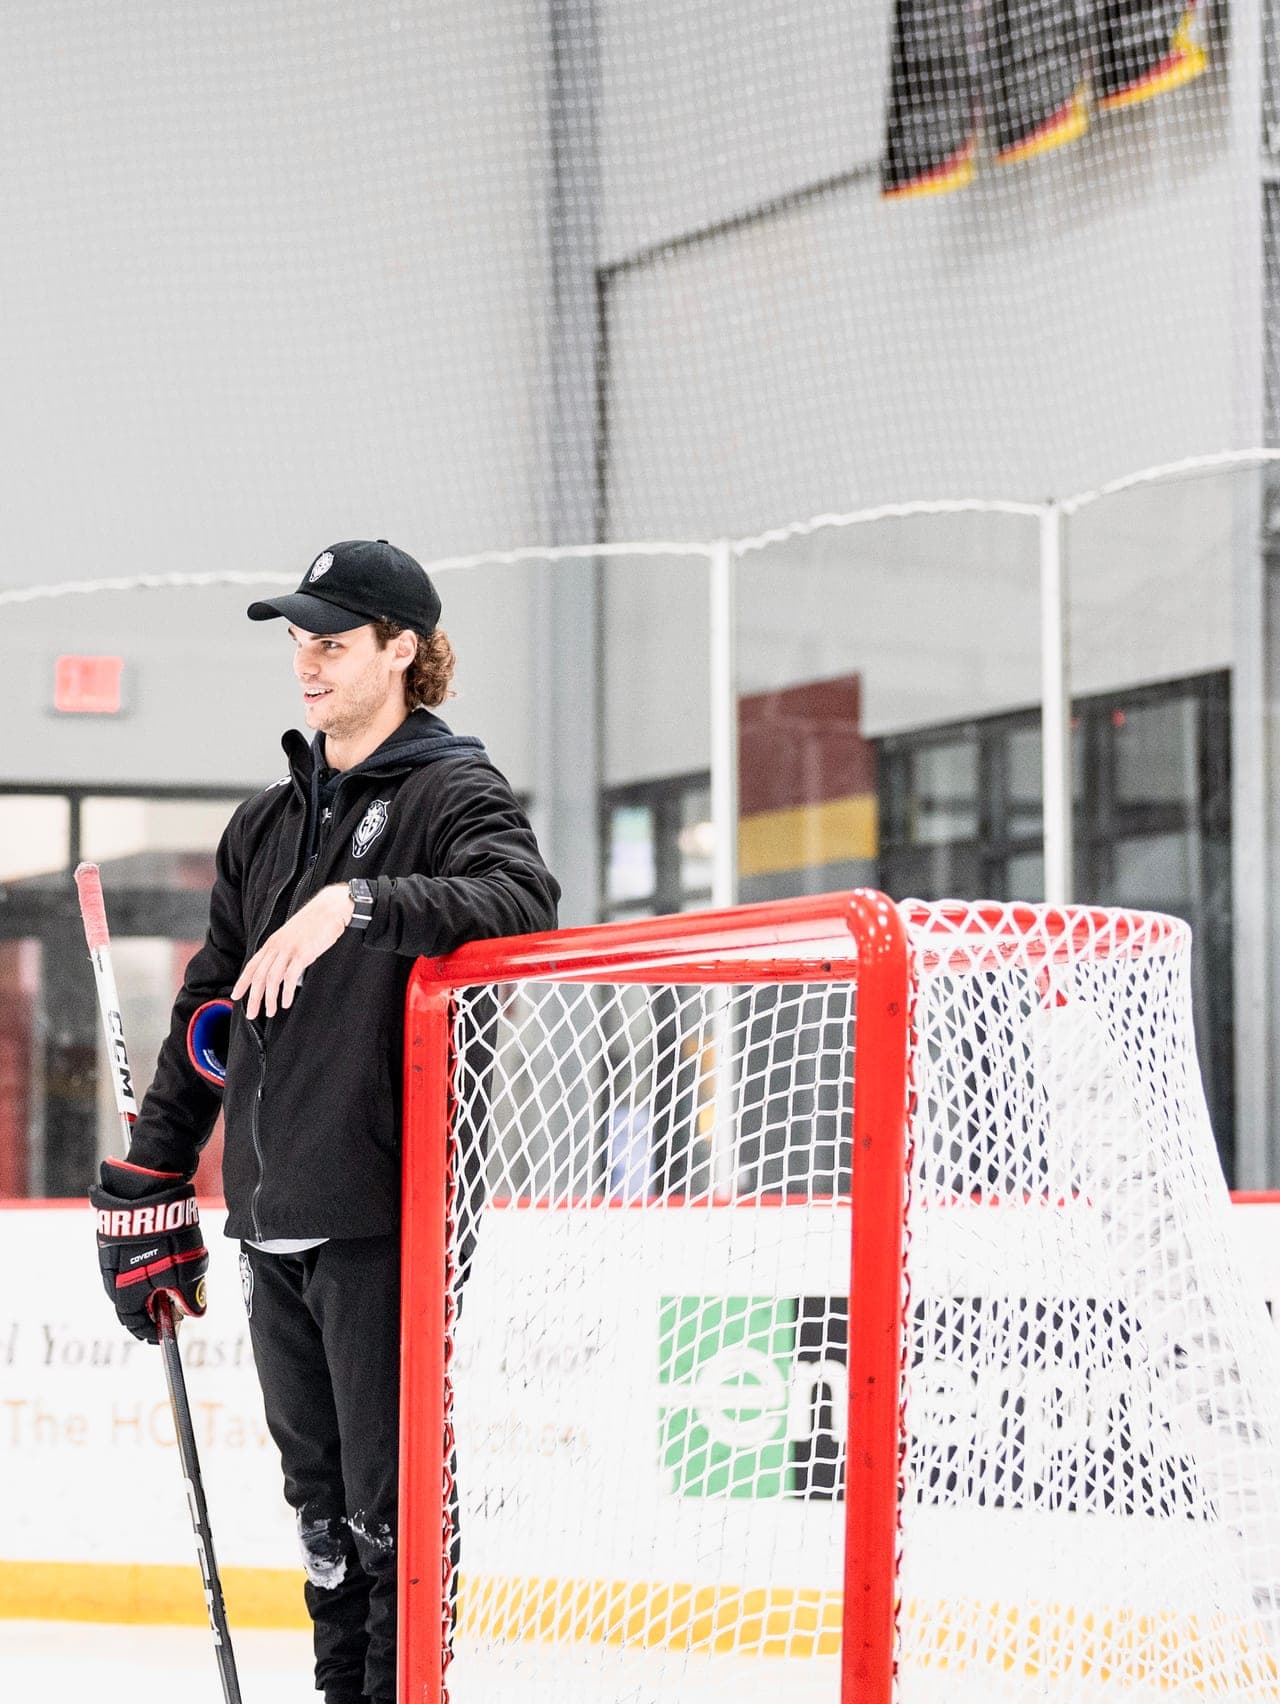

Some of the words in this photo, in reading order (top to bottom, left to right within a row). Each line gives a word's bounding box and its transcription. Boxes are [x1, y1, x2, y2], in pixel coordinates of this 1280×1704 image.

[94, 1197, 200, 1237] ARRIOR
[130, 1248, 159, 1265] COVERT
[41, 1321, 141, 1368] Your
[2, 1396, 89, 1449] The
